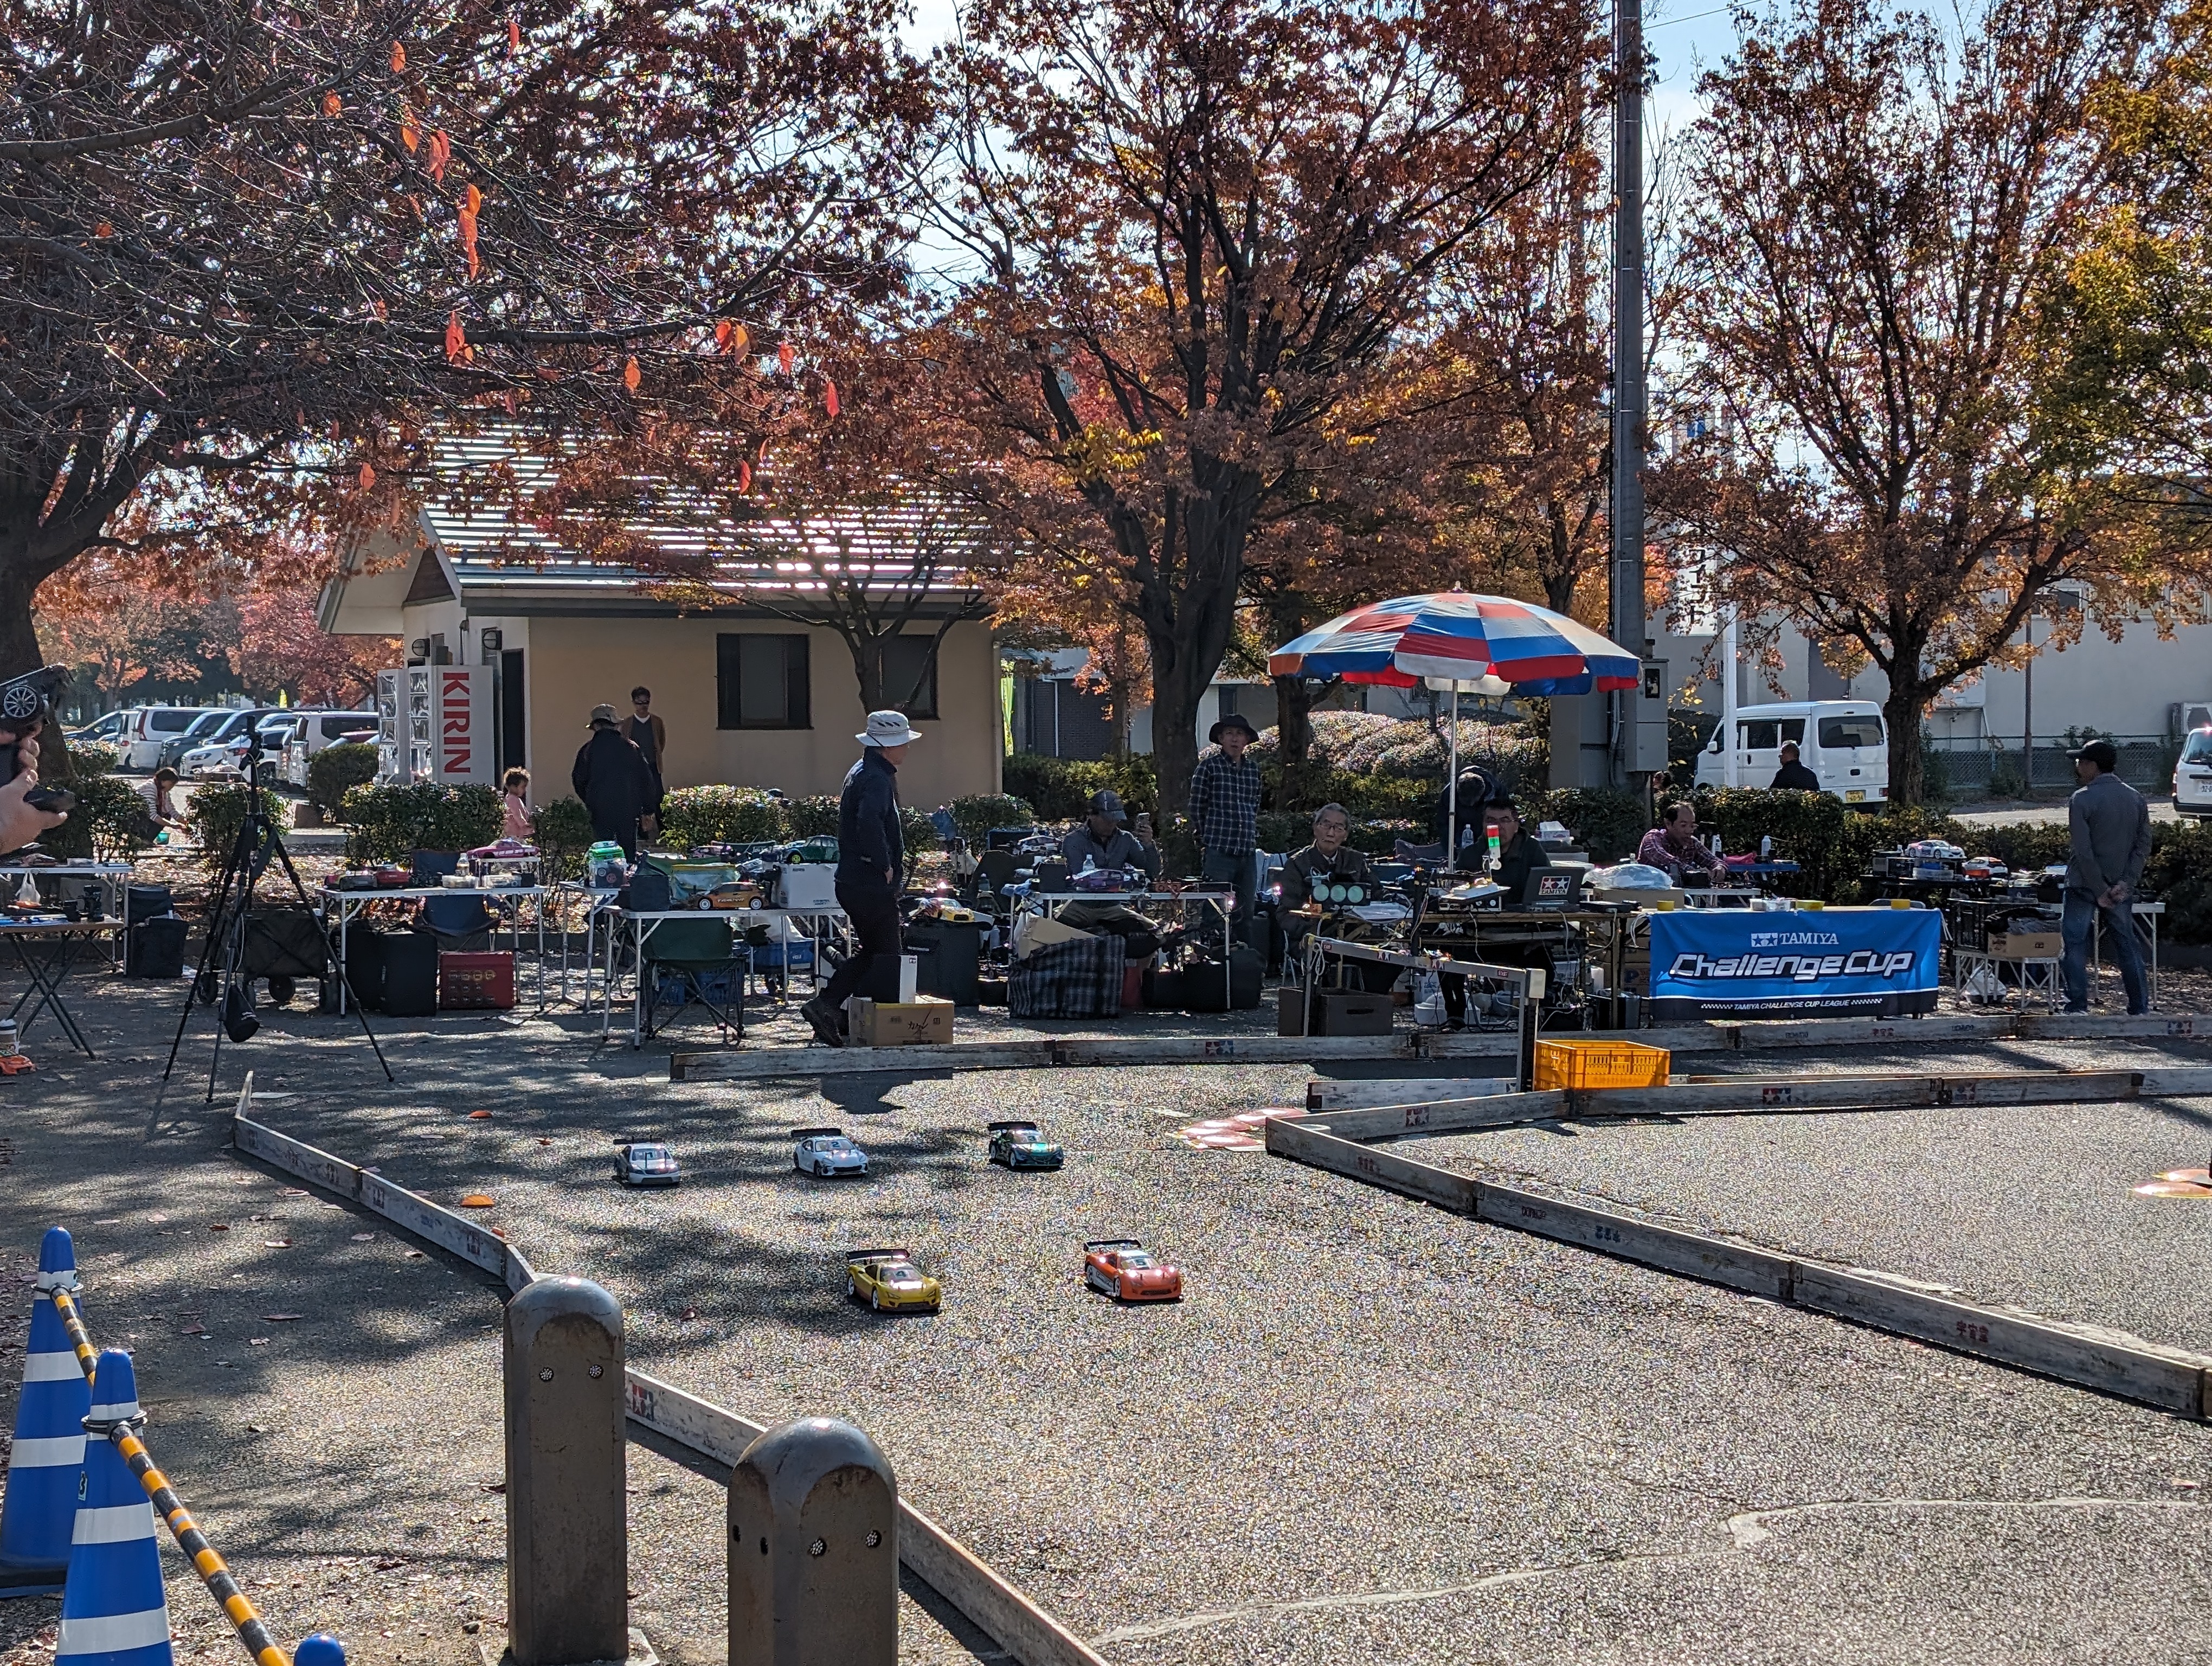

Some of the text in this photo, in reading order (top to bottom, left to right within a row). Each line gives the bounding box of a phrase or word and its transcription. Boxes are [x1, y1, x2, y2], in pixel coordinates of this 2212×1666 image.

[442, 672, 471, 773] KIRIN
[1779, 932, 1839, 945] TAMIYA
[1669, 951, 1913, 981] Challenge Cup
